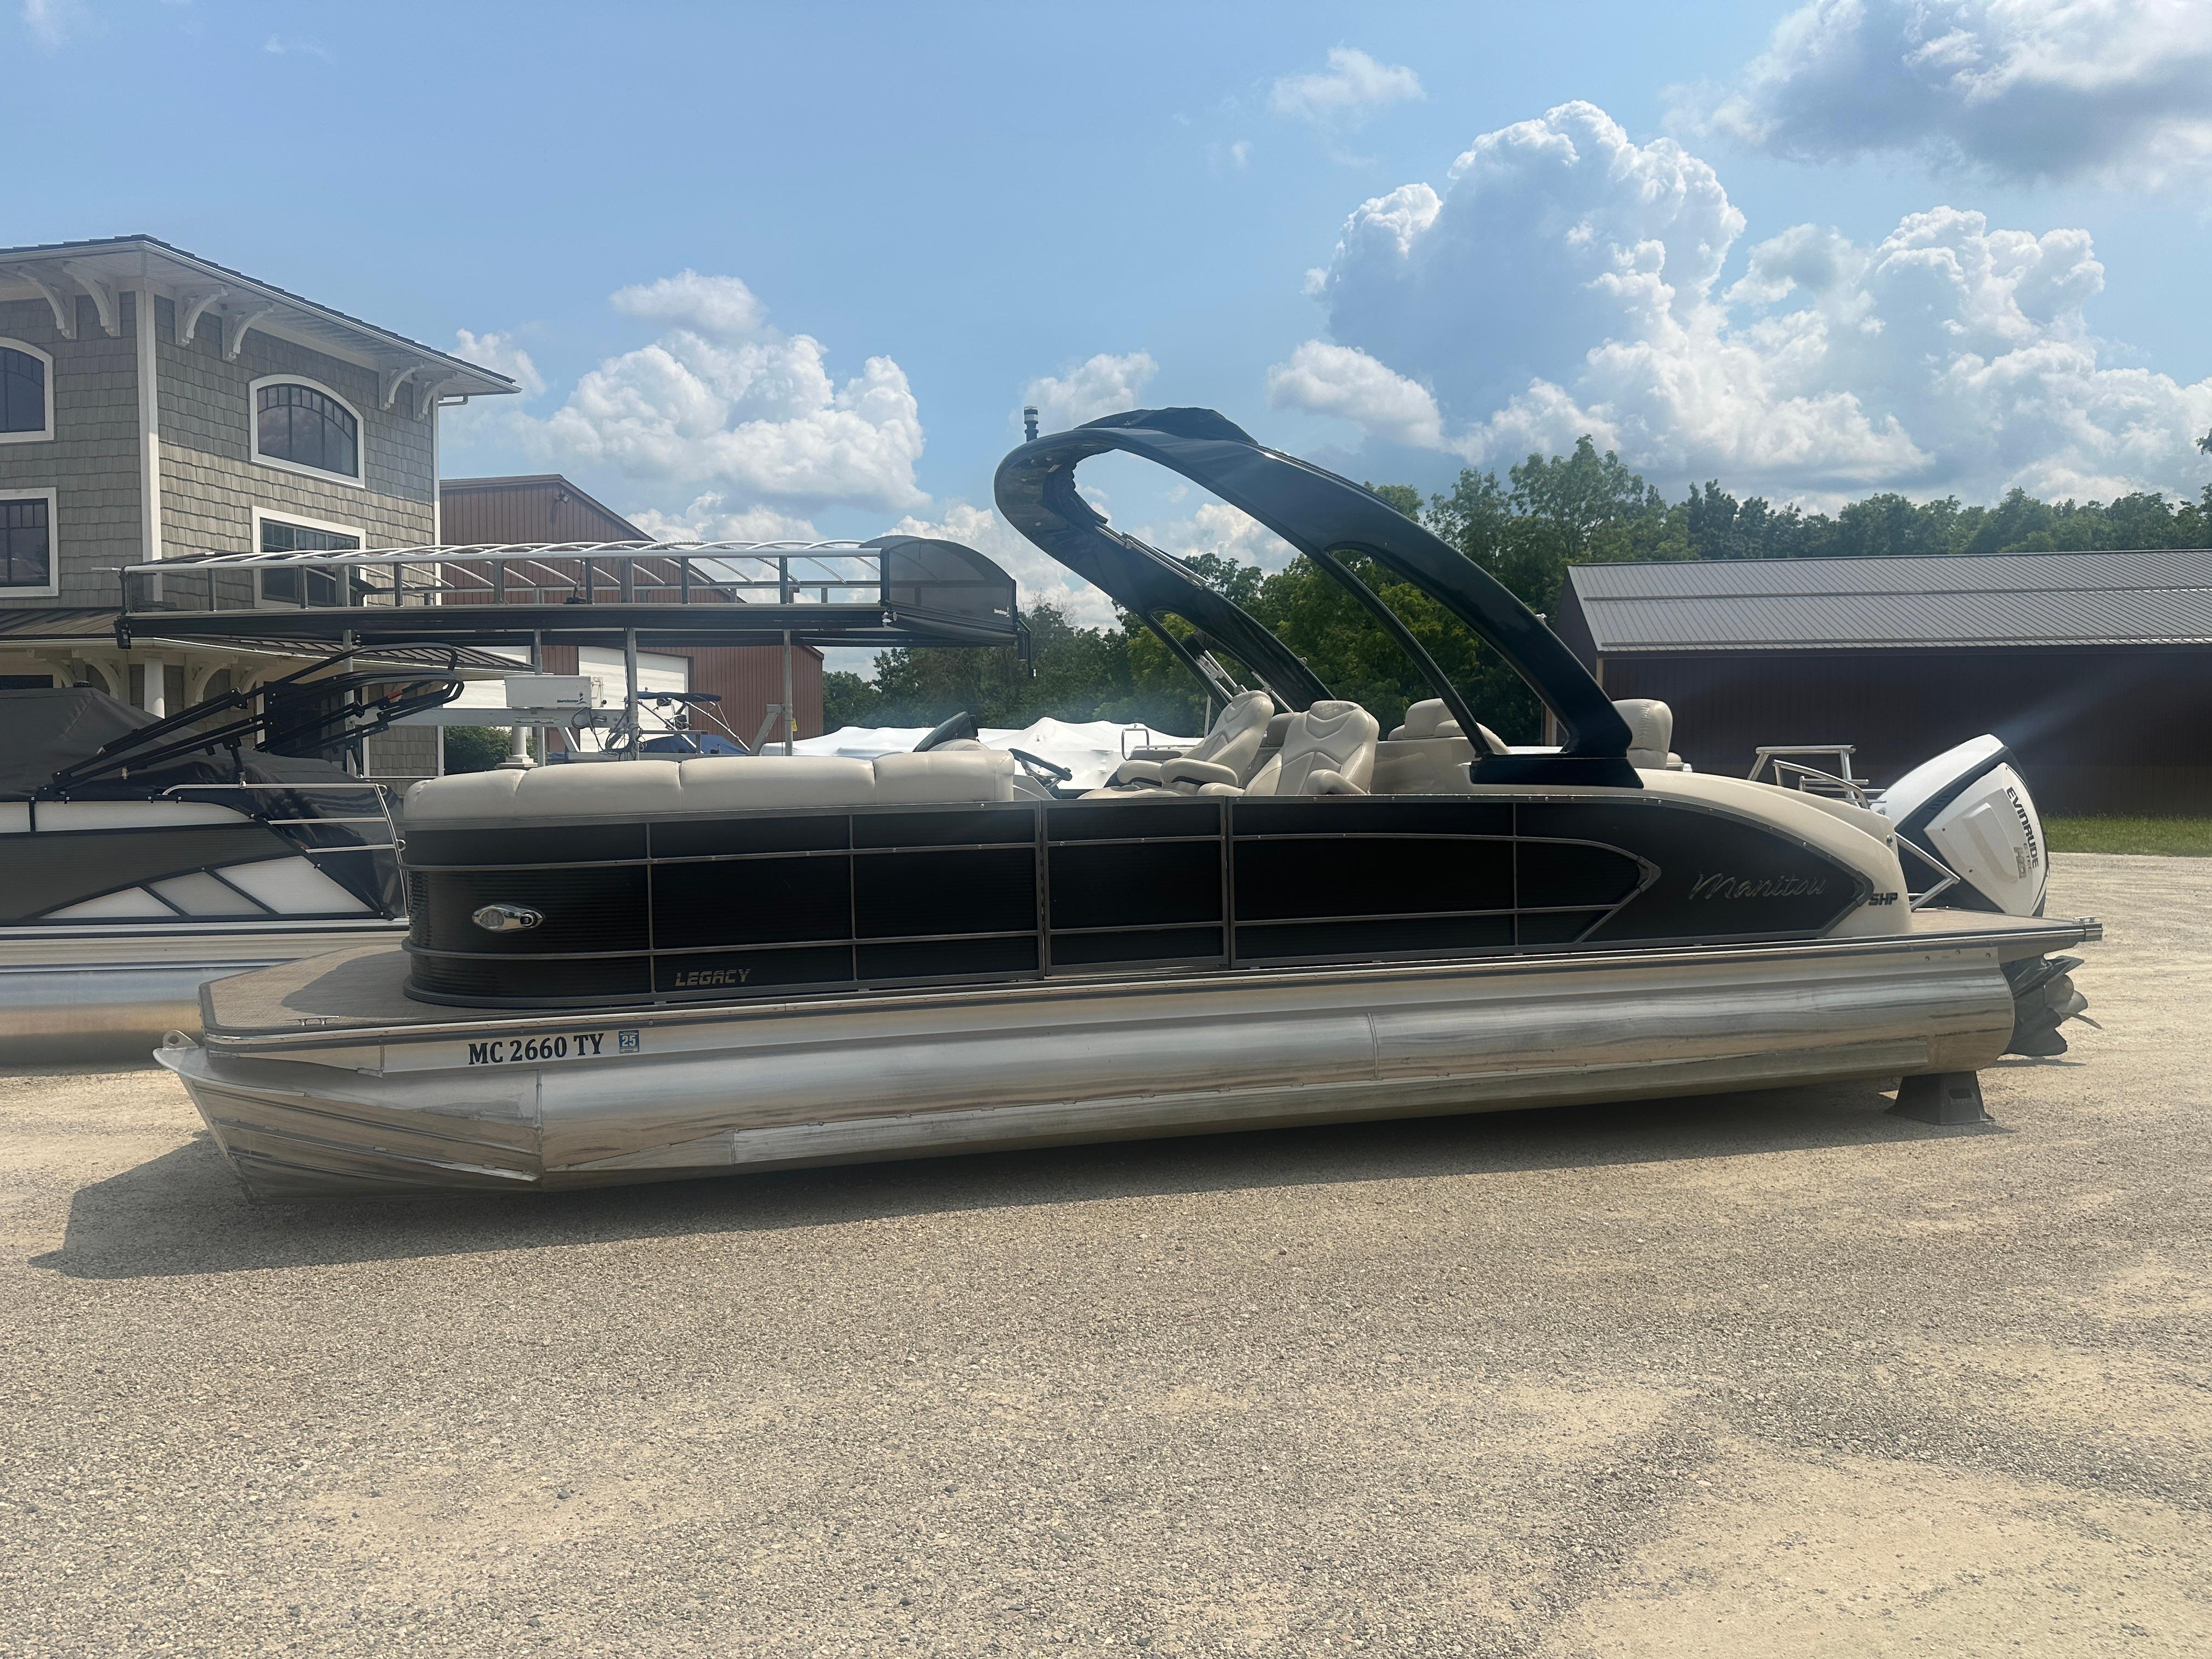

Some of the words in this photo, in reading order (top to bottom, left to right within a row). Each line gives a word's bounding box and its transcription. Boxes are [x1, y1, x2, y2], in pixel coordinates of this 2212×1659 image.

[2006, 786, 2039, 869] EVINRUDE
[1689, 871, 1826, 900] Manitou
[1869, 892, 1898, 906] SHP
[675, 968, 751, 986] LEGACY
[469, 1041, 503, 1065] MC
[510, 1036, 567, 1062] 2660
[573, 1033, 604, 1056] TY
[622, 1035, 636, 1046] 25
